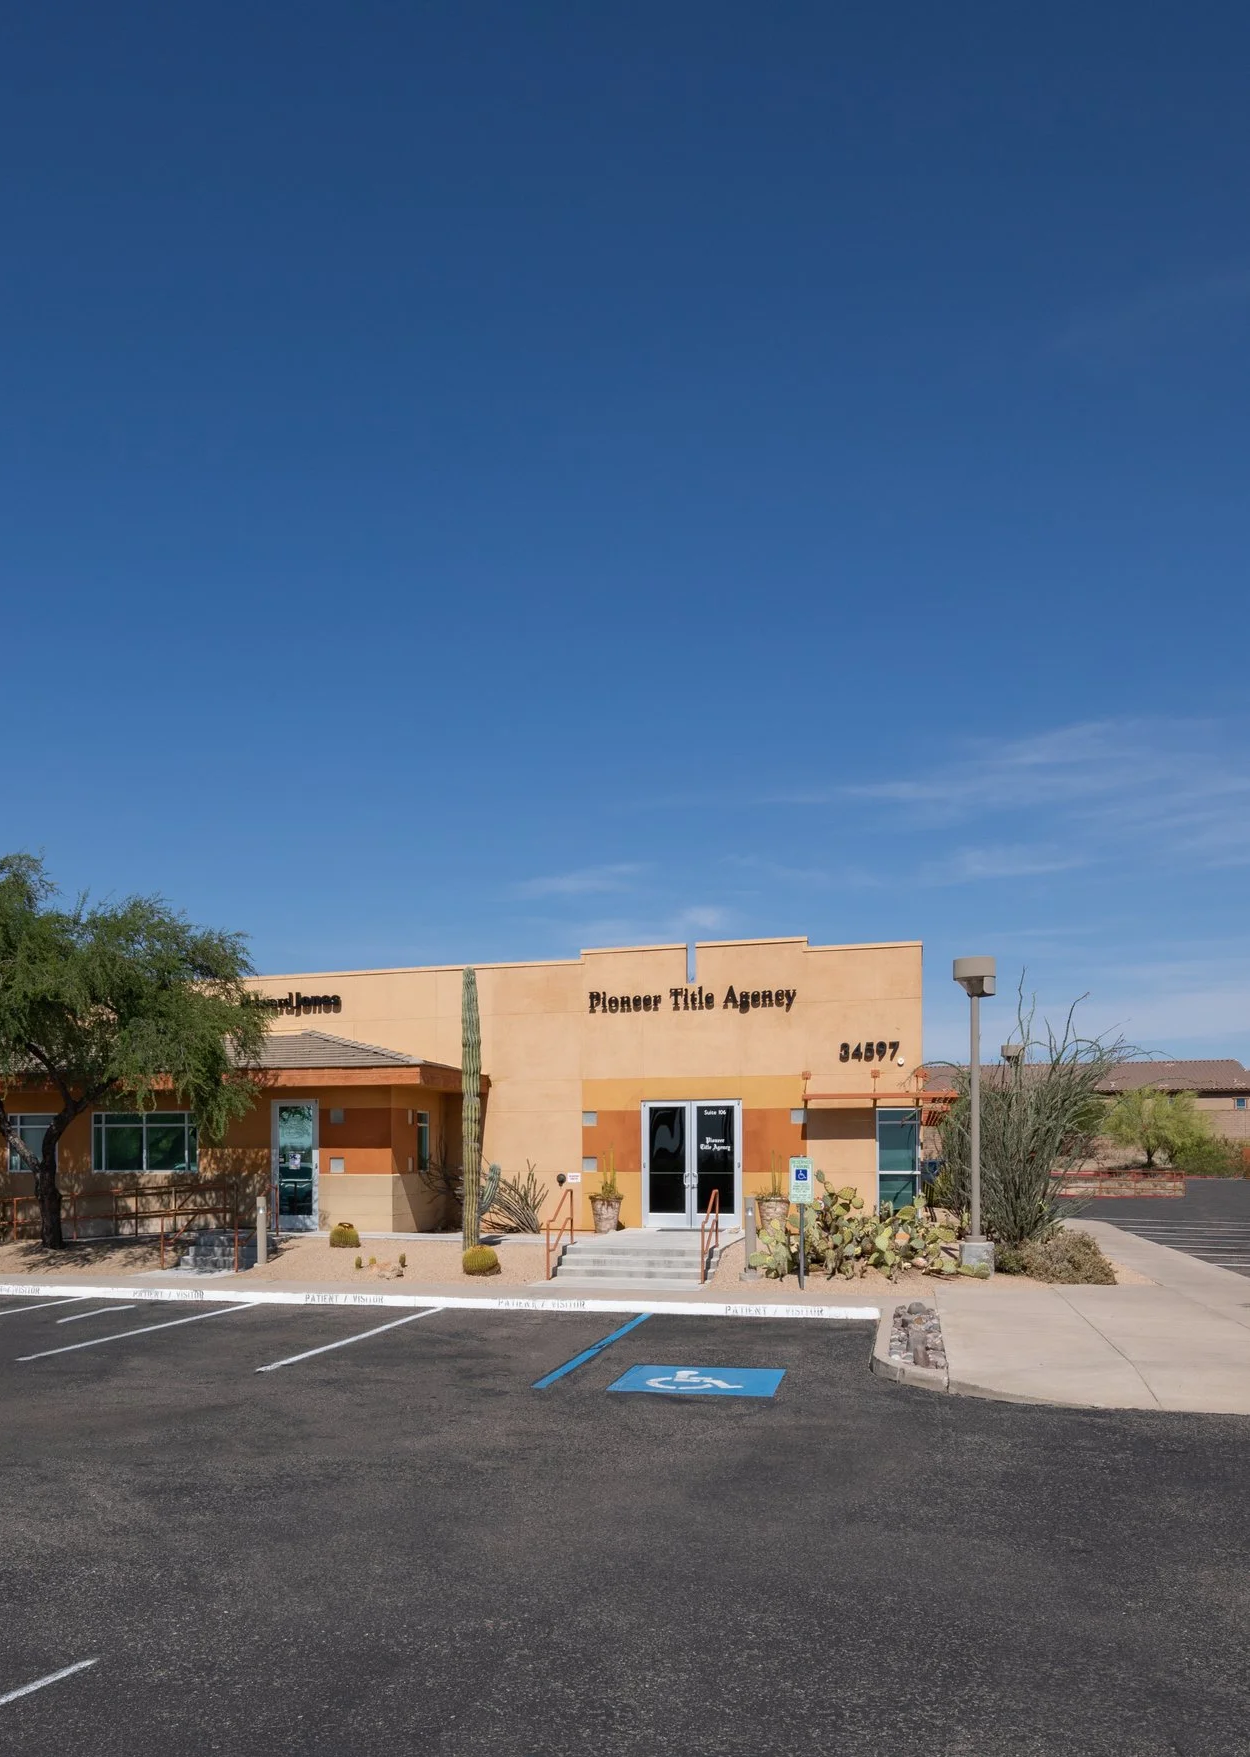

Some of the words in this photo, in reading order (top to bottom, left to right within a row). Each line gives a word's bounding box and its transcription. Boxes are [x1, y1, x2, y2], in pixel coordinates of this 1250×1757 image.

[295, 991, 342, 1016] Jones
[589, 990, 662, 1013] Pioneer
[669, 986, 715, 1011] Title
[723, 985, 797, 1013] Agency
[839, 1041, 900, 1063] 34597
[132, 1289, 163, 1298] PATIENT
[305, 1294, 338, 1303] PATIENT
[352, 1295, 384, 1304] VISITOR
[551, 1301, 586, 1309] VISITOR
[725, 1305, 767, 1316] PATIENT
[786, 1307, 824, 1316] VISITOR
